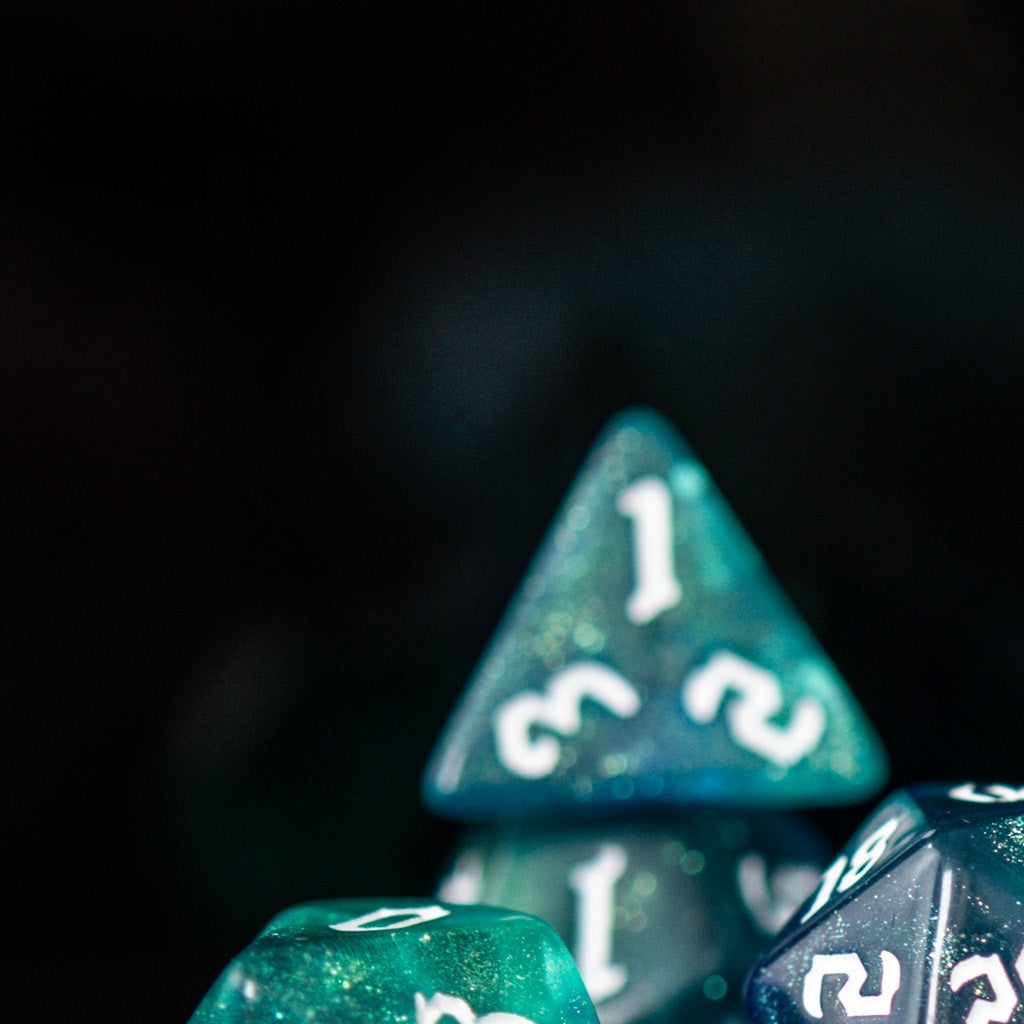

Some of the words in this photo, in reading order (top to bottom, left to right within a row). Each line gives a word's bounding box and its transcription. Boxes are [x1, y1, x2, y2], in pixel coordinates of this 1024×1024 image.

[617, 475, 680, 624] 1
[494, 660, 640, 780] 3
[683, 650, 826, 767] 2
[803, 950, 901, 1019] 2
